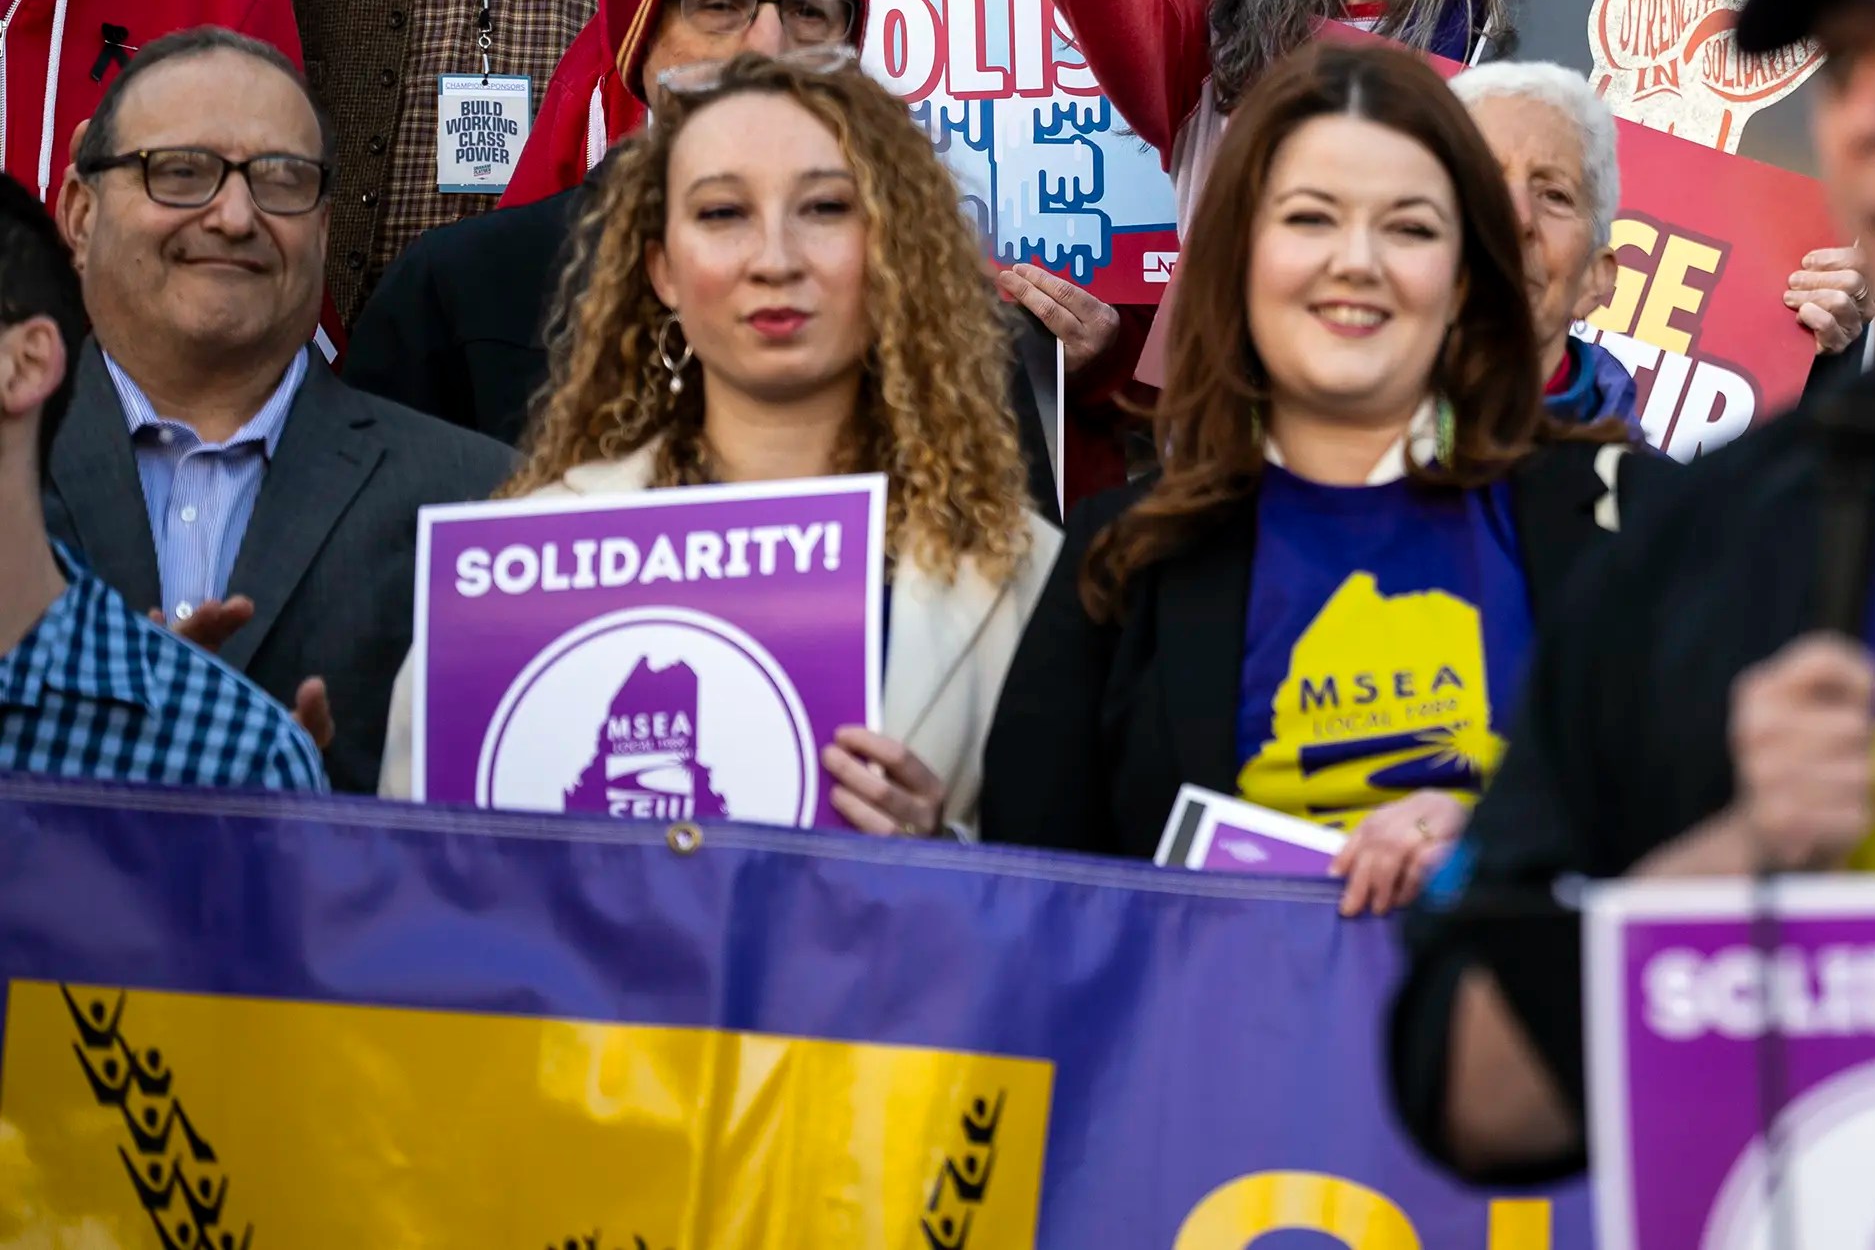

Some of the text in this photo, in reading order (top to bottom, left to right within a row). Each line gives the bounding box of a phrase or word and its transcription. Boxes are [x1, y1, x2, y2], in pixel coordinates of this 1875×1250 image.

[1633, 55, 1681, 95] IN
[461, 100, 503, 117] BUILD
[446, 116, 518, 136] WORKING
[458, 131, 506, 148] CLASS
[455, 147, 510, 165] POWER
[1587, 218, 1723, 356] GE
[454, 521, 844, 599] SOLIDARITY!
[1300, 664, 1466, 714] MSEA
[606, 710, 693, 742] MSEA
